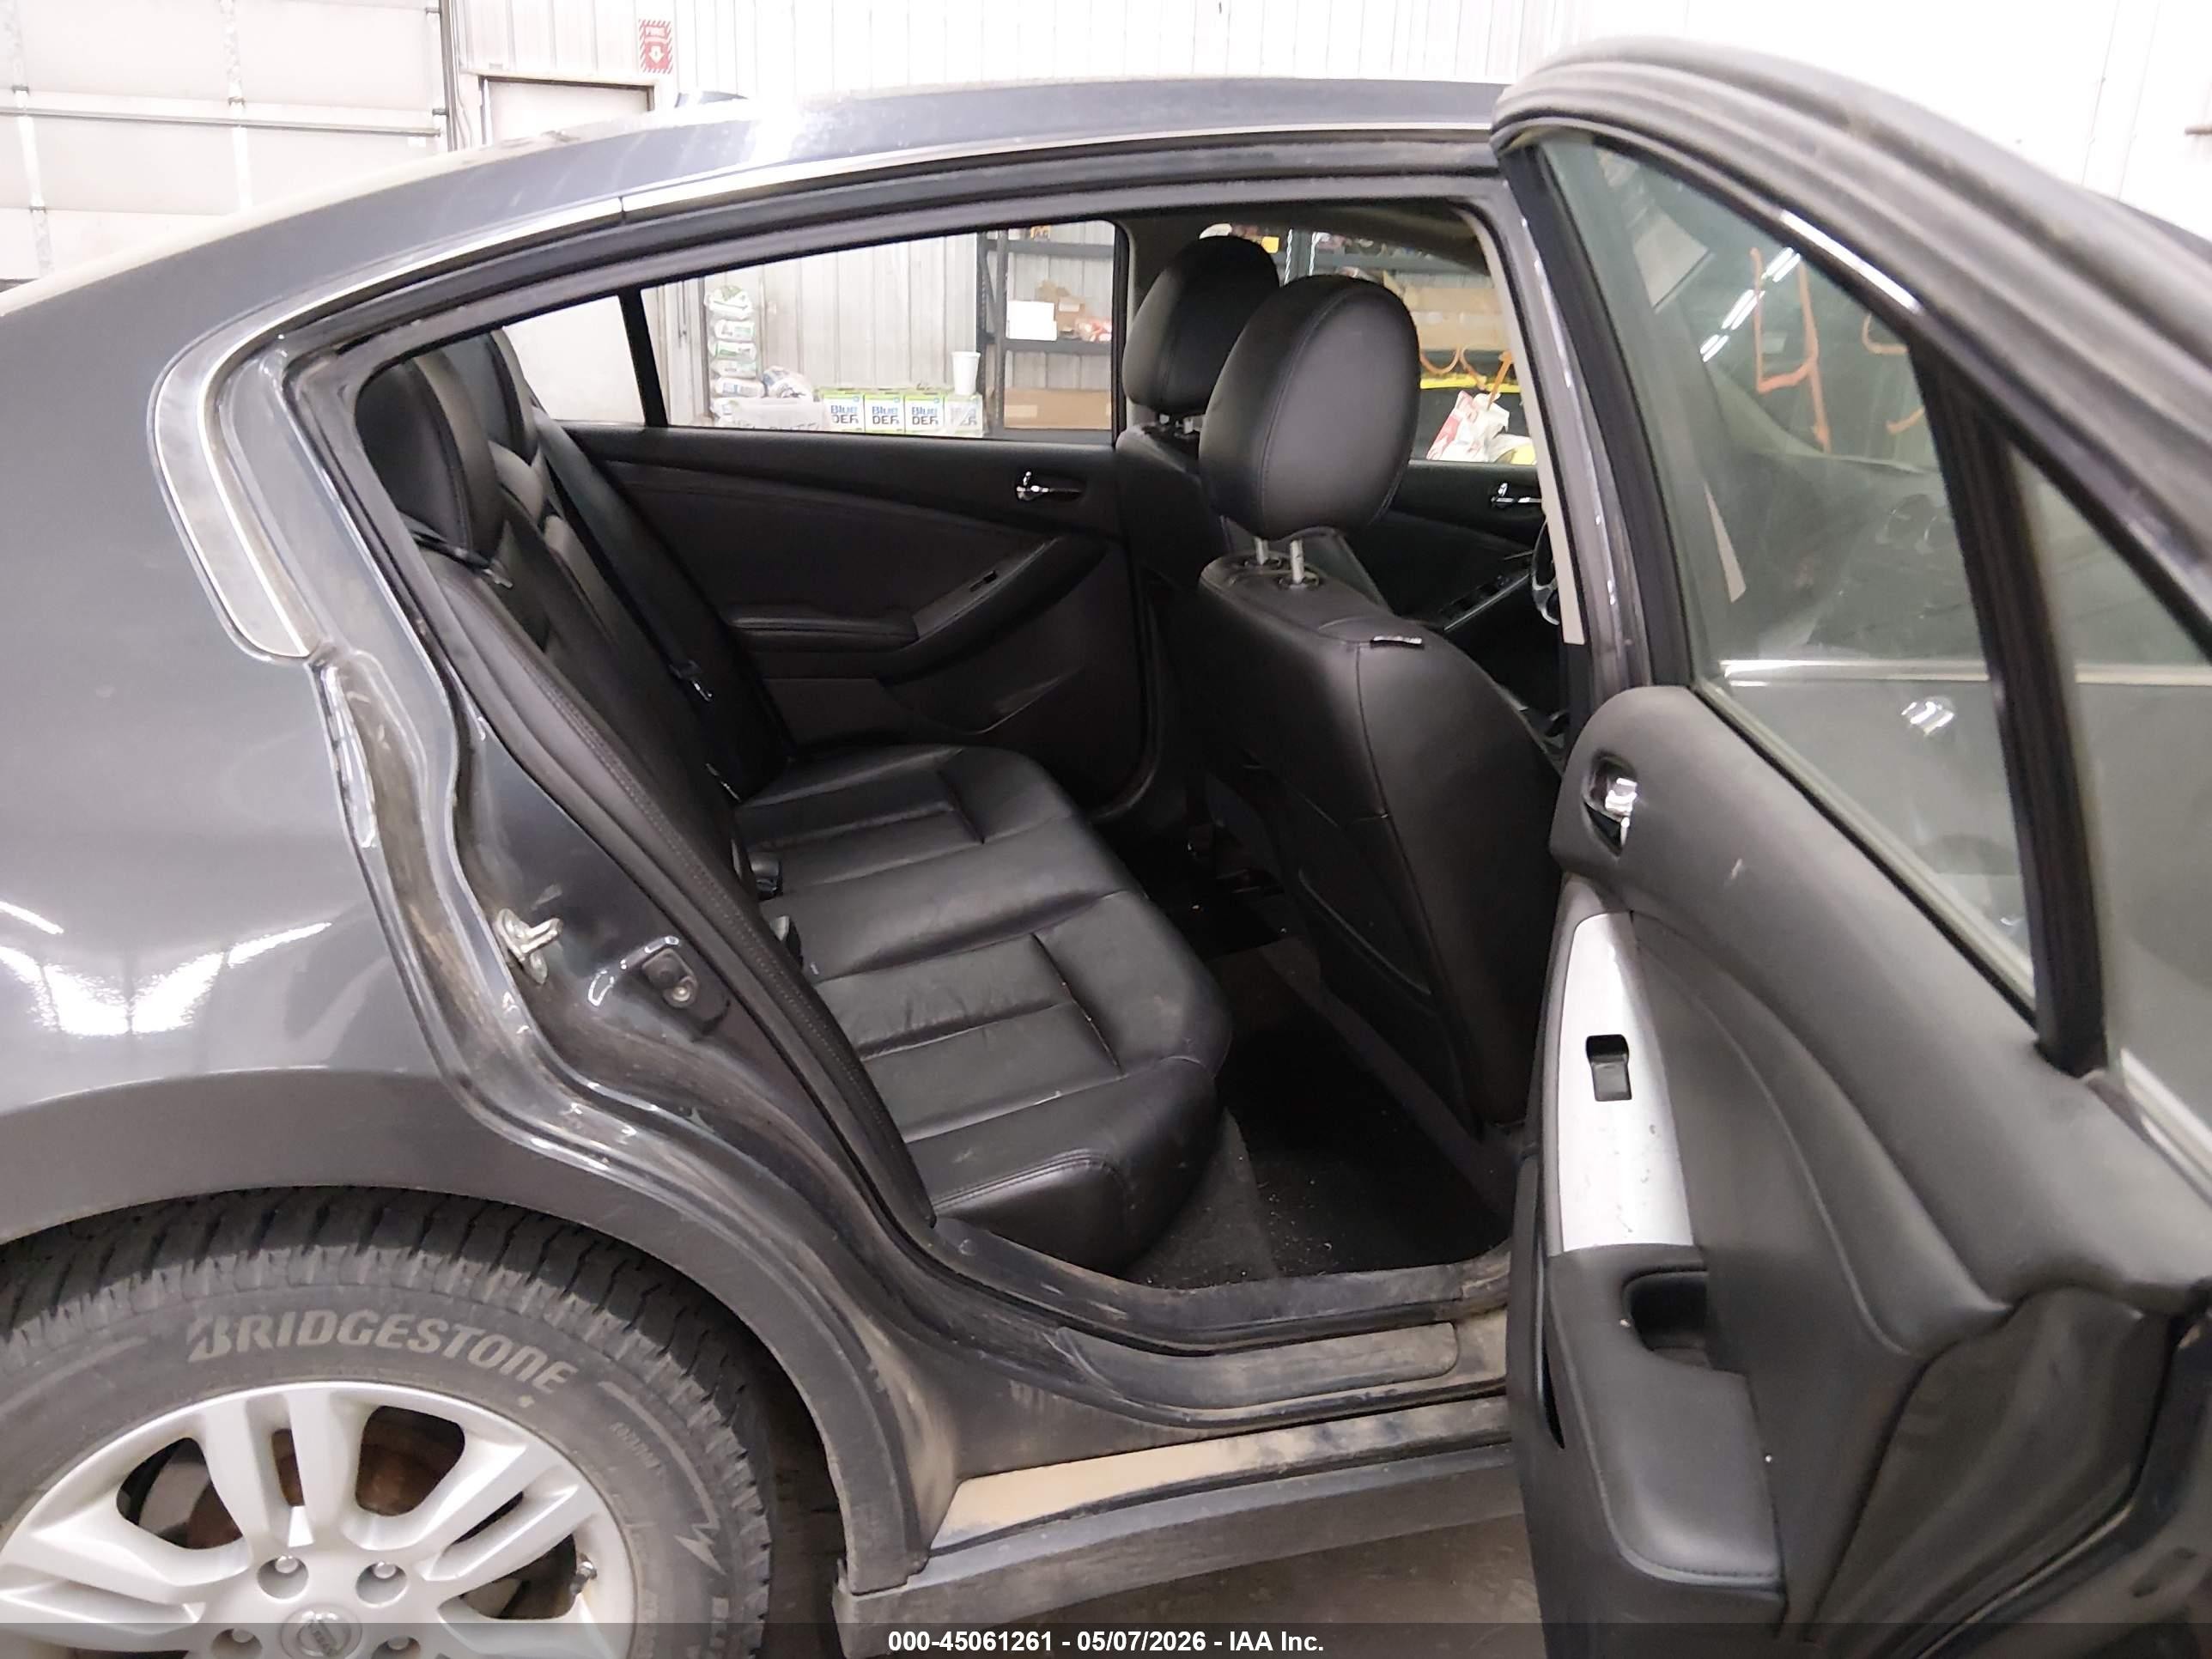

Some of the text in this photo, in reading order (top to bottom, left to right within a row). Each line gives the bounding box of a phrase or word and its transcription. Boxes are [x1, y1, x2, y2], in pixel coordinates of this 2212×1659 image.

[830, 404, 859, 414] Blue
[872, 406, 898, 416] Blue
[911, 406, 938, 416] Blue
[186, 1309, 580, 1395] BRIDGESTONE
